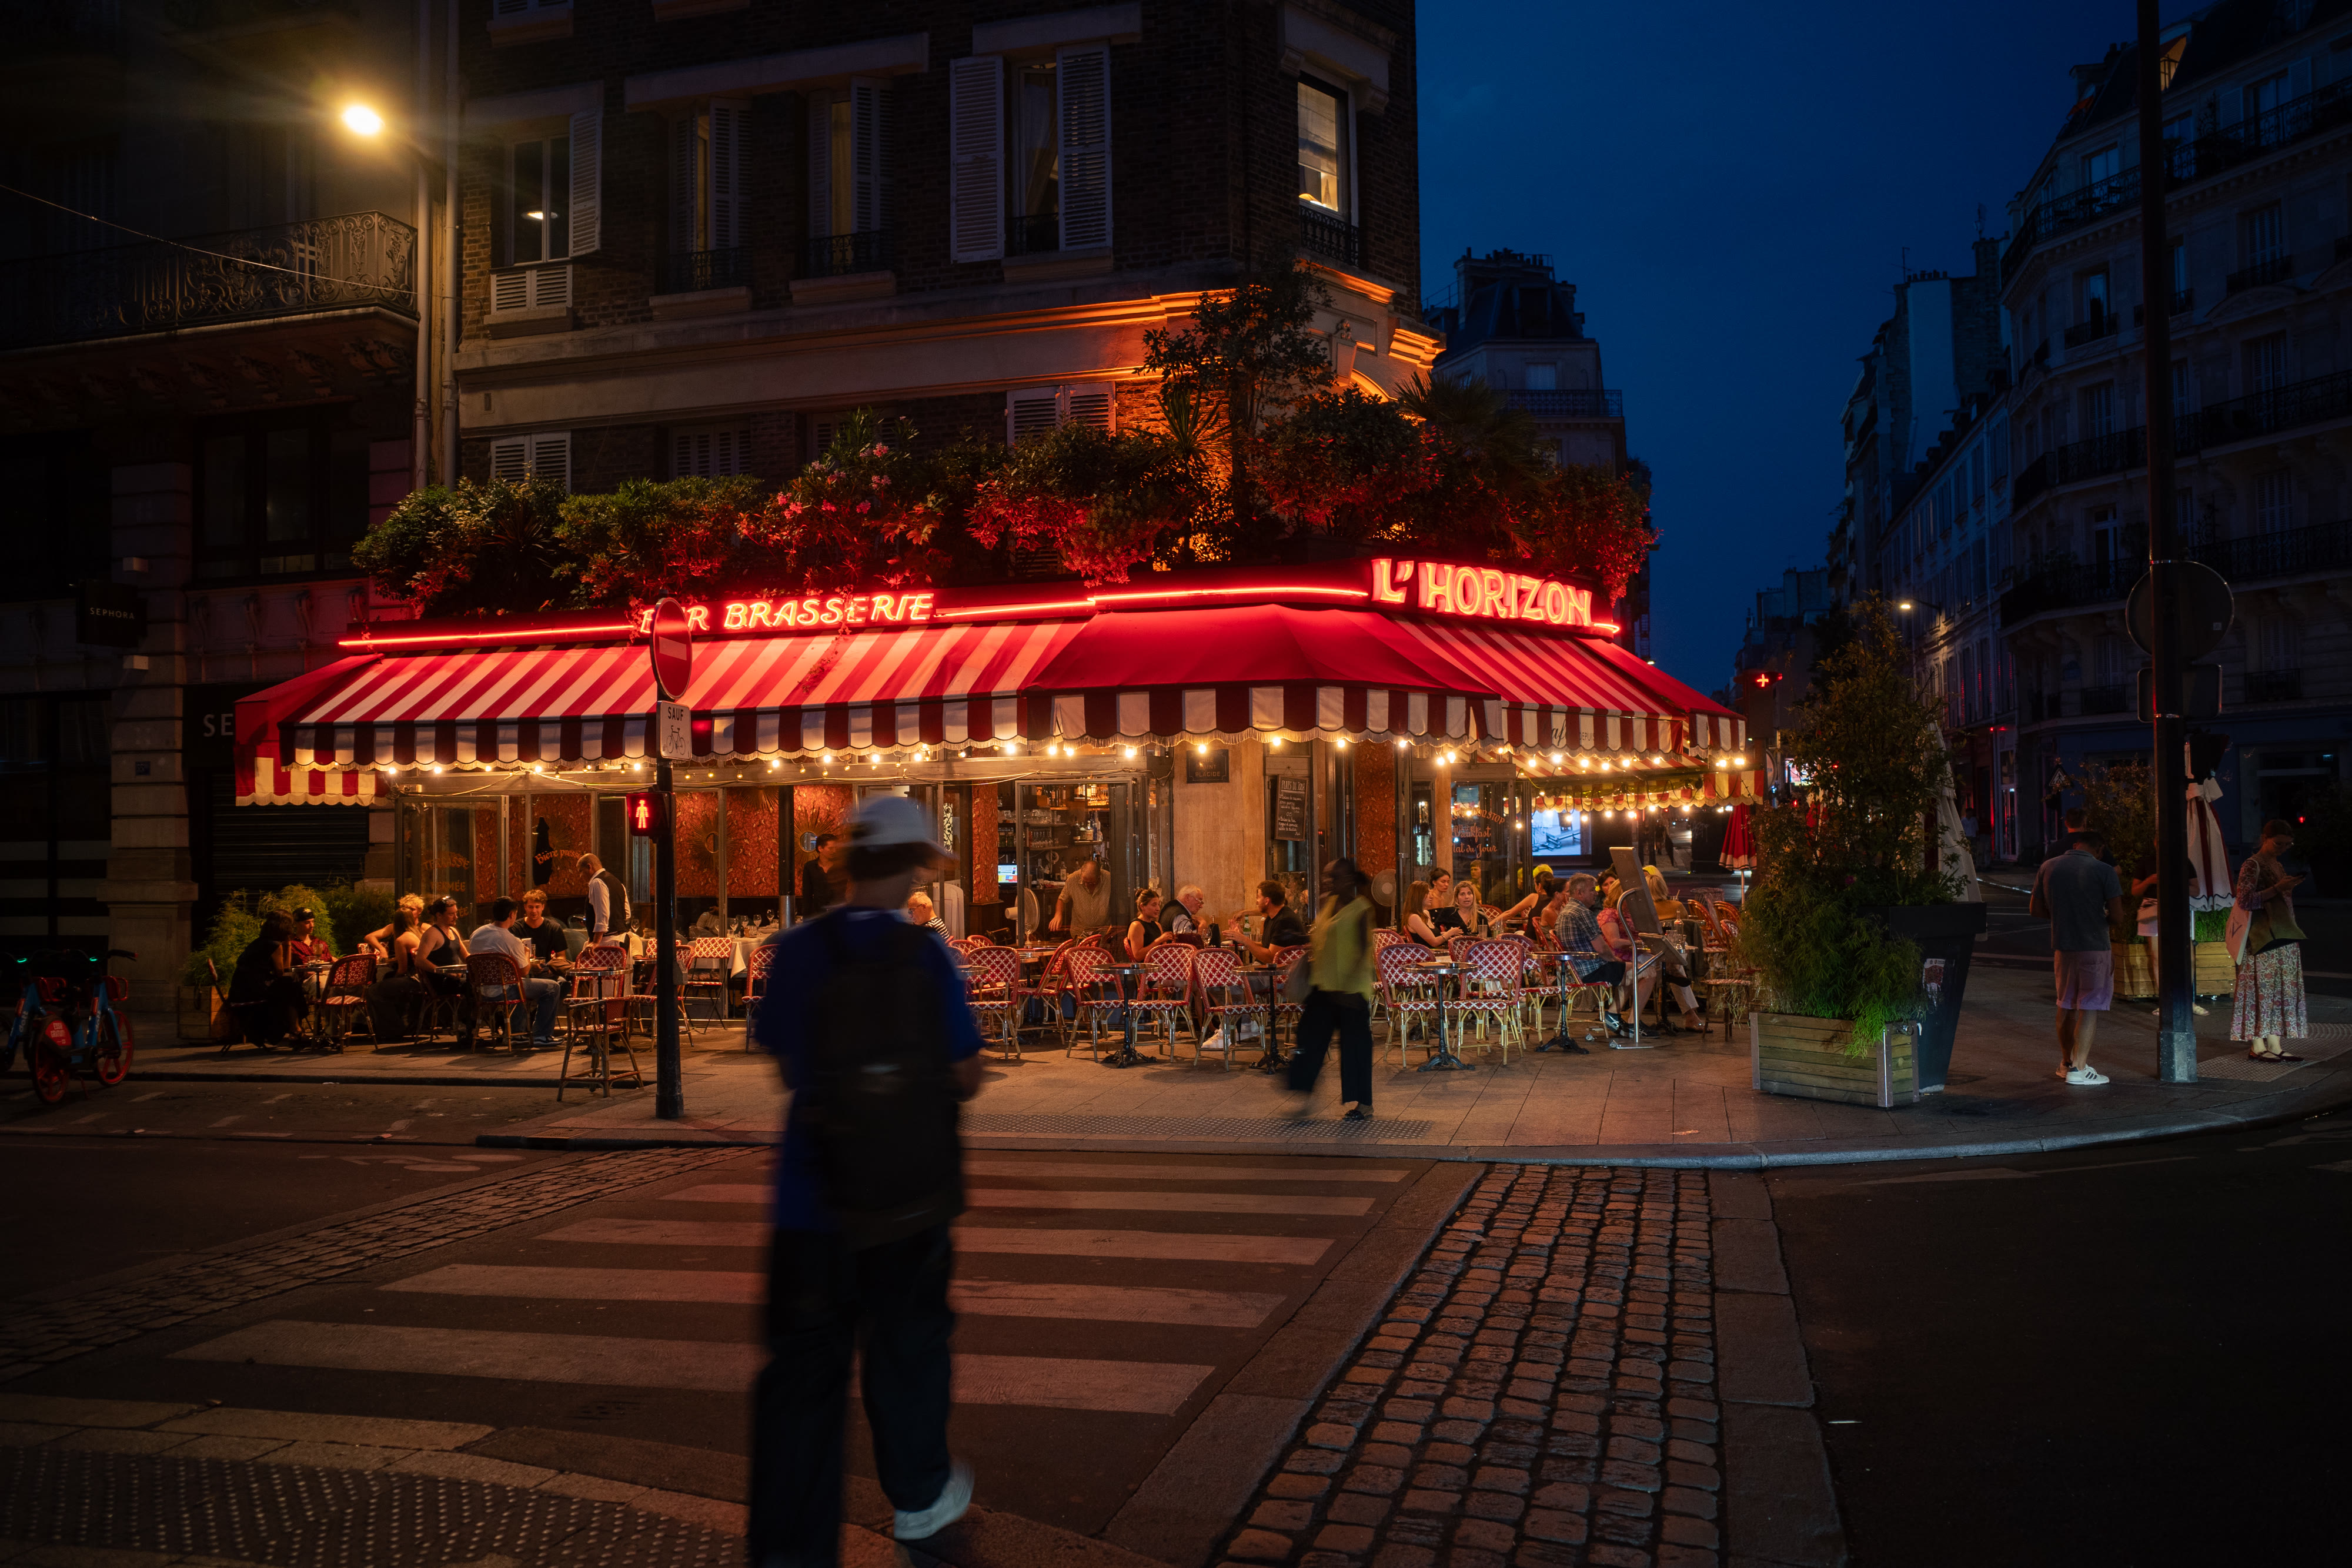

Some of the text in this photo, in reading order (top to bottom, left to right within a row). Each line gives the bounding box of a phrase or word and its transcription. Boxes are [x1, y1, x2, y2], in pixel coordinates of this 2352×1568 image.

[1372, 558, 1592, 627] L'HORIZON
[89, 607, 135, 619] SEPHORA
[724, 593, 934, 629] BRASSERIE
[668, 707, 683, 721] SAUF
[1281, 780, 1292, 790] PLATS
[1292, 781, 1297, 790] DU
[1453, 842, 1465, 853] lat
[1476, 843, 1498, 858] Jour
